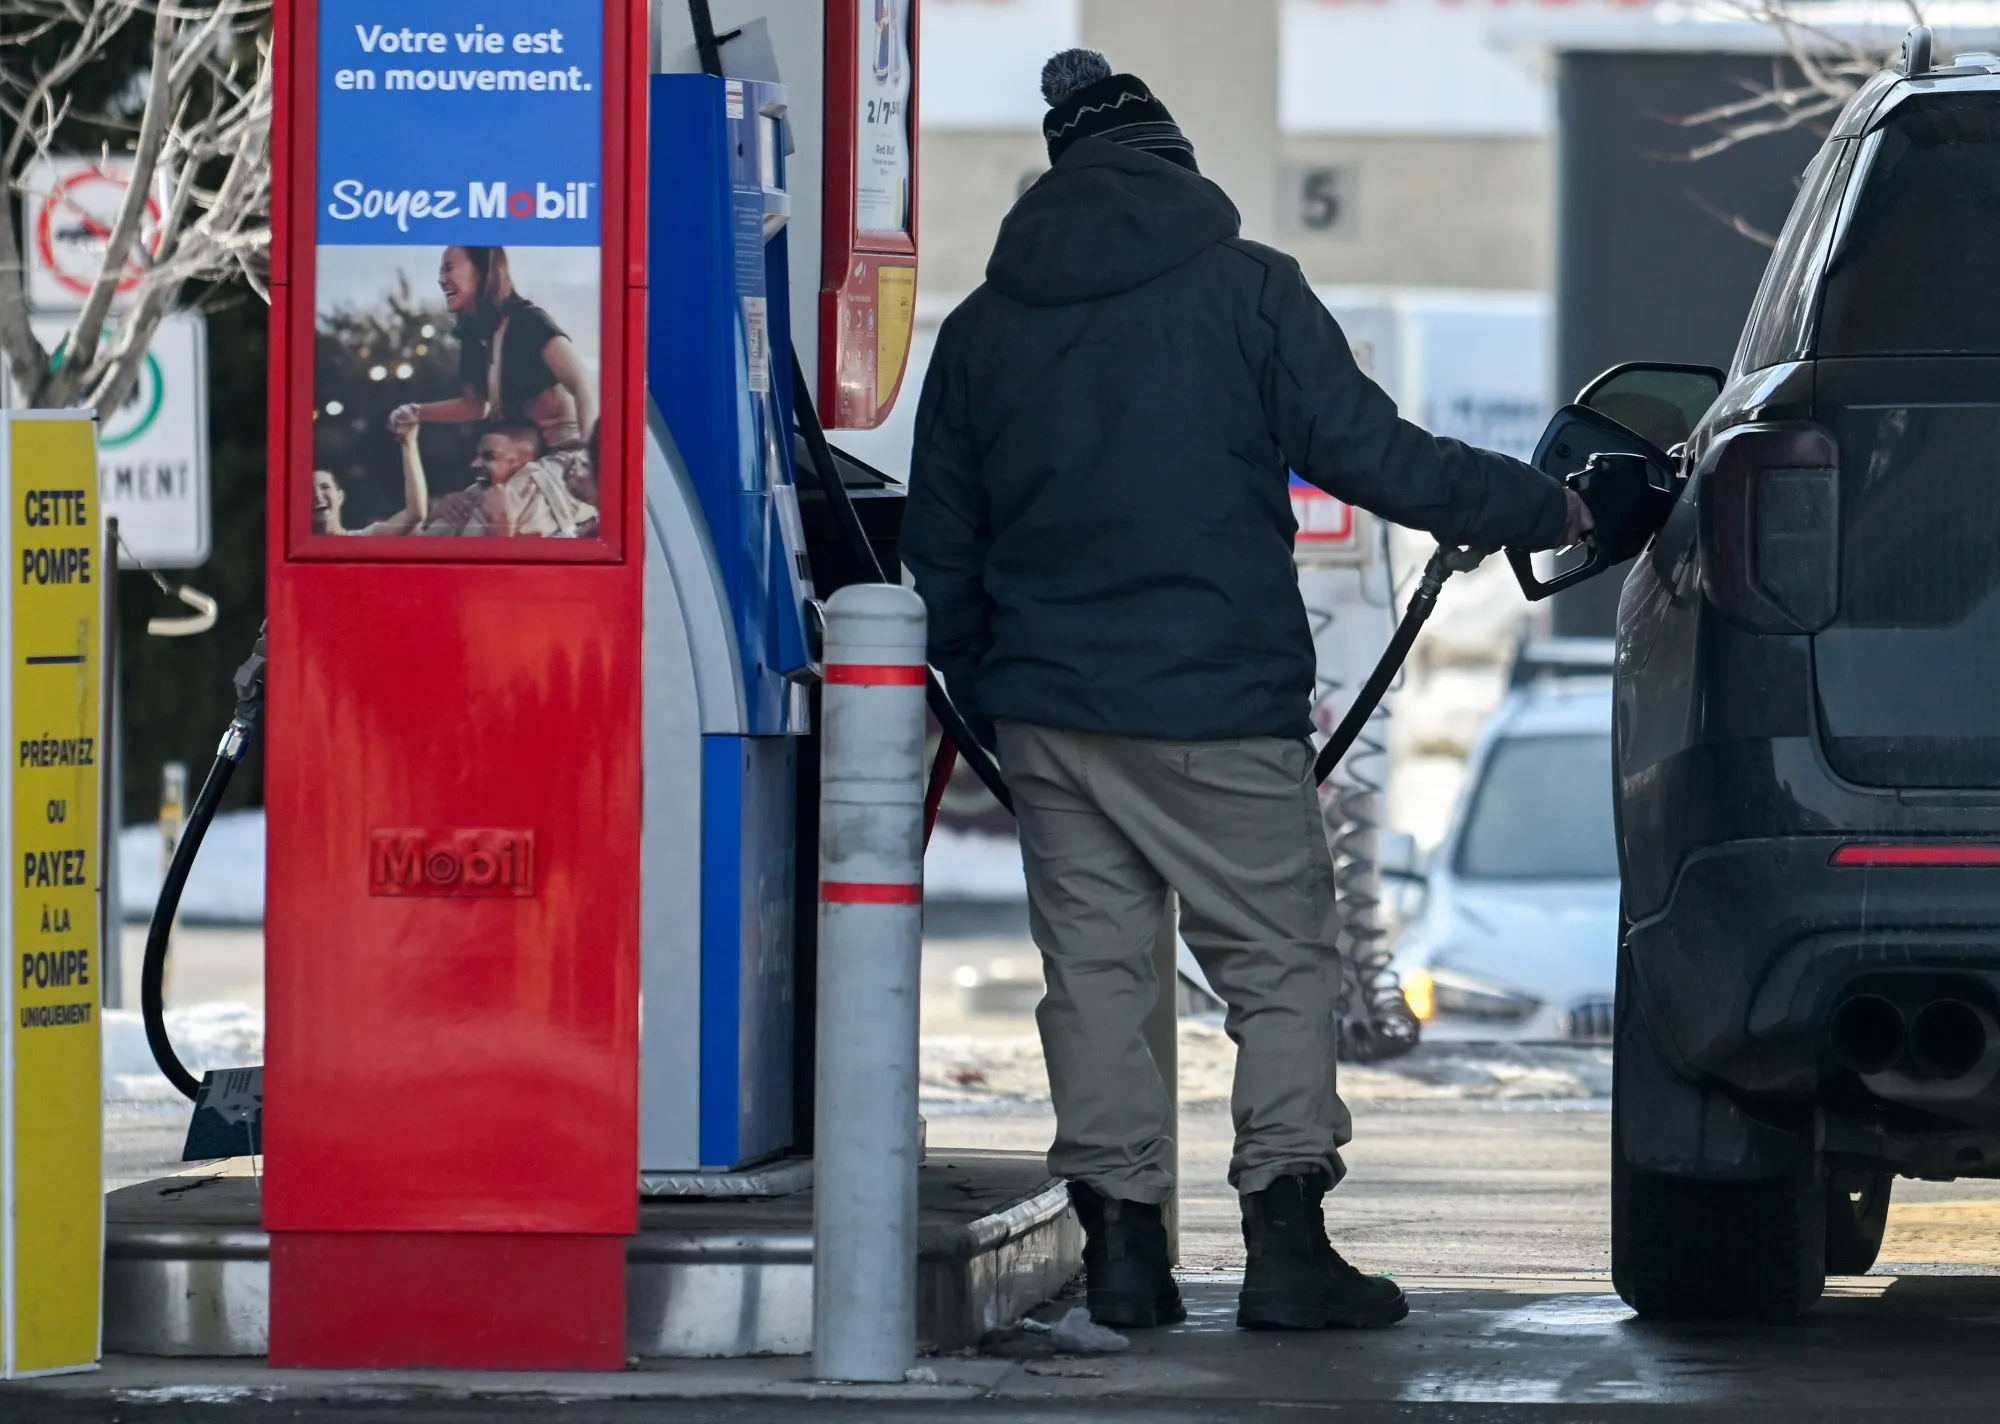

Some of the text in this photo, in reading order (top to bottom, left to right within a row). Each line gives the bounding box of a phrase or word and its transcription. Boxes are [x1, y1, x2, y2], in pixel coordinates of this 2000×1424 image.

[355, 24, 564, 53] Votre vie est
[335, 66, 592, 91] en mouvement.
[328, 179, 588, 232] Soyez Mobil
[1302, 168, 1341, 230] 5
[24, 490, 87, 527] CETTE
[22, 548, 90, 585] POMPE
[20, 733, 94, 767] PRÉPAYEZ
[47, 800, 66, 823] OU
[24, 850, 85, 888] PAYEZ
[375, 838, 529, 885] Mobil
[41, 904, 71, 933] À LA
[22, 950, 88, 988] POMPE
[20, 1003, 92, 1029] UNIQUEMENT
